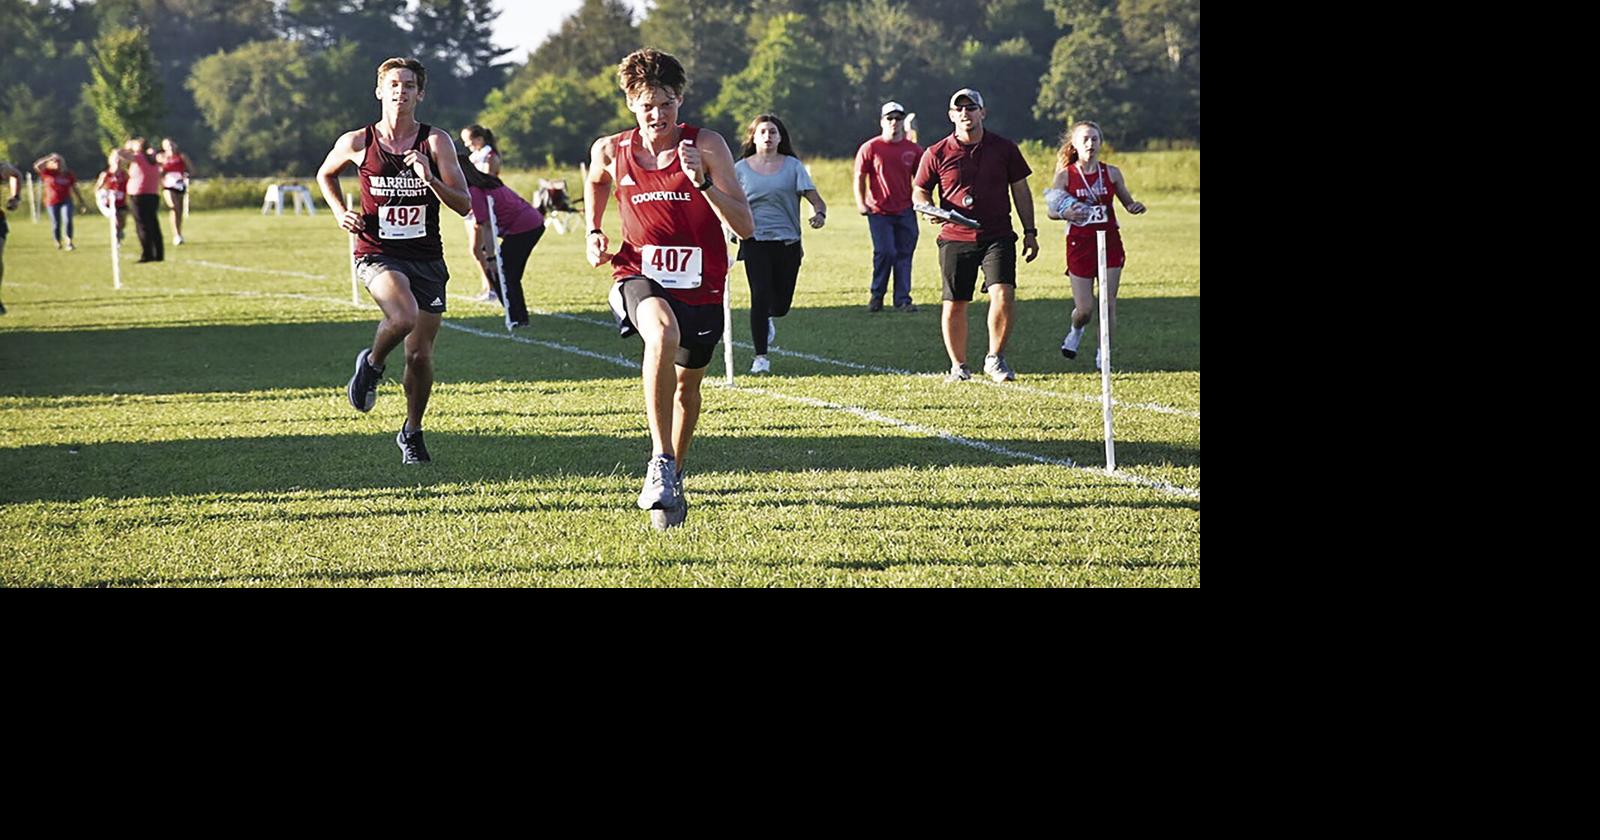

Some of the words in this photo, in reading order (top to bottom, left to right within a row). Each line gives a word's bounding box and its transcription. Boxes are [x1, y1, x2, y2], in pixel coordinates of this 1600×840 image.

[370, 187, 396, 197] WHITE
[396, 188, 427, 197] COUNTY
[631, 190, 692, 205] COOKEVILLE
[385, 207, 420, 226] 492
[651, 248, 693, 272] 407
